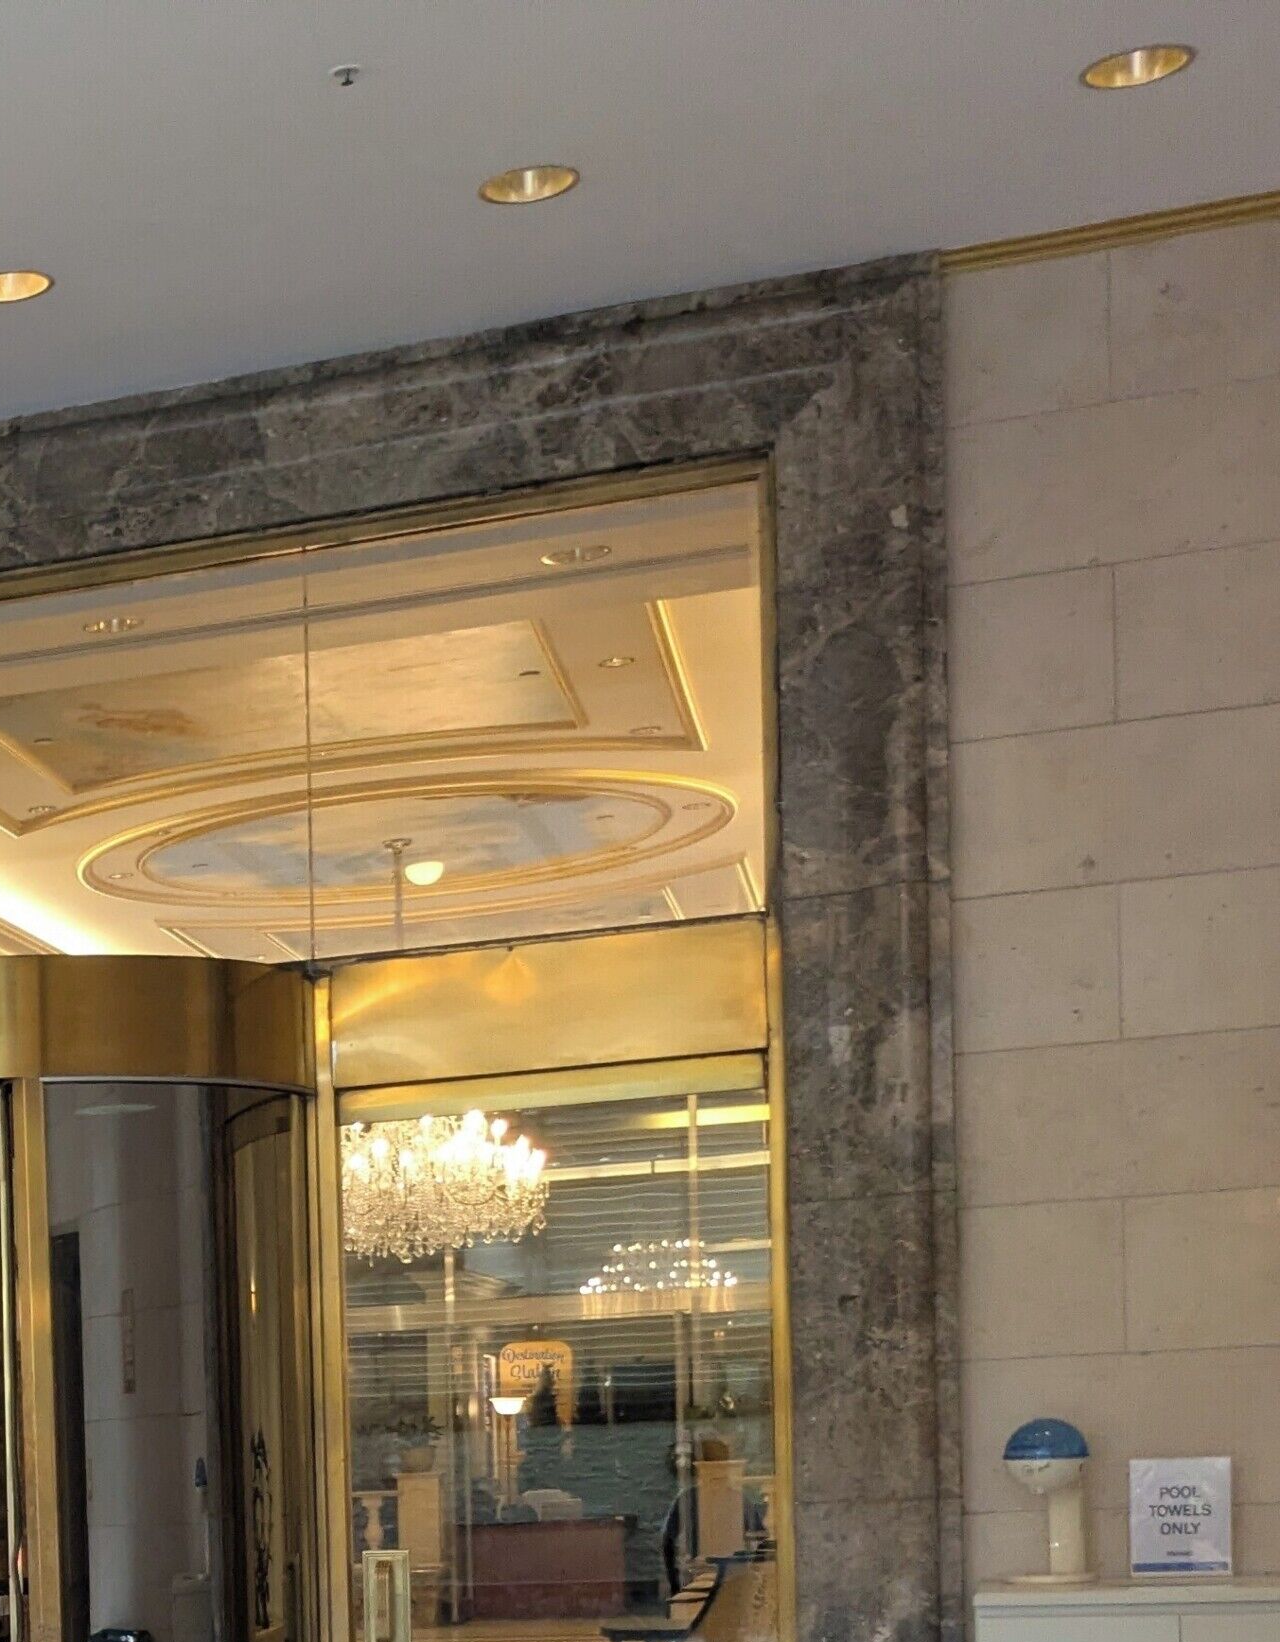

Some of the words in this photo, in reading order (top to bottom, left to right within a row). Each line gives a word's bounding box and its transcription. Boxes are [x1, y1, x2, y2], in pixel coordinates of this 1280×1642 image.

[1160, 1486, 1200, 1499] POOL
[1149, 1504, 1212, 1517] TOWELS
[1161, 1522, 1201, 1535] ONLY
